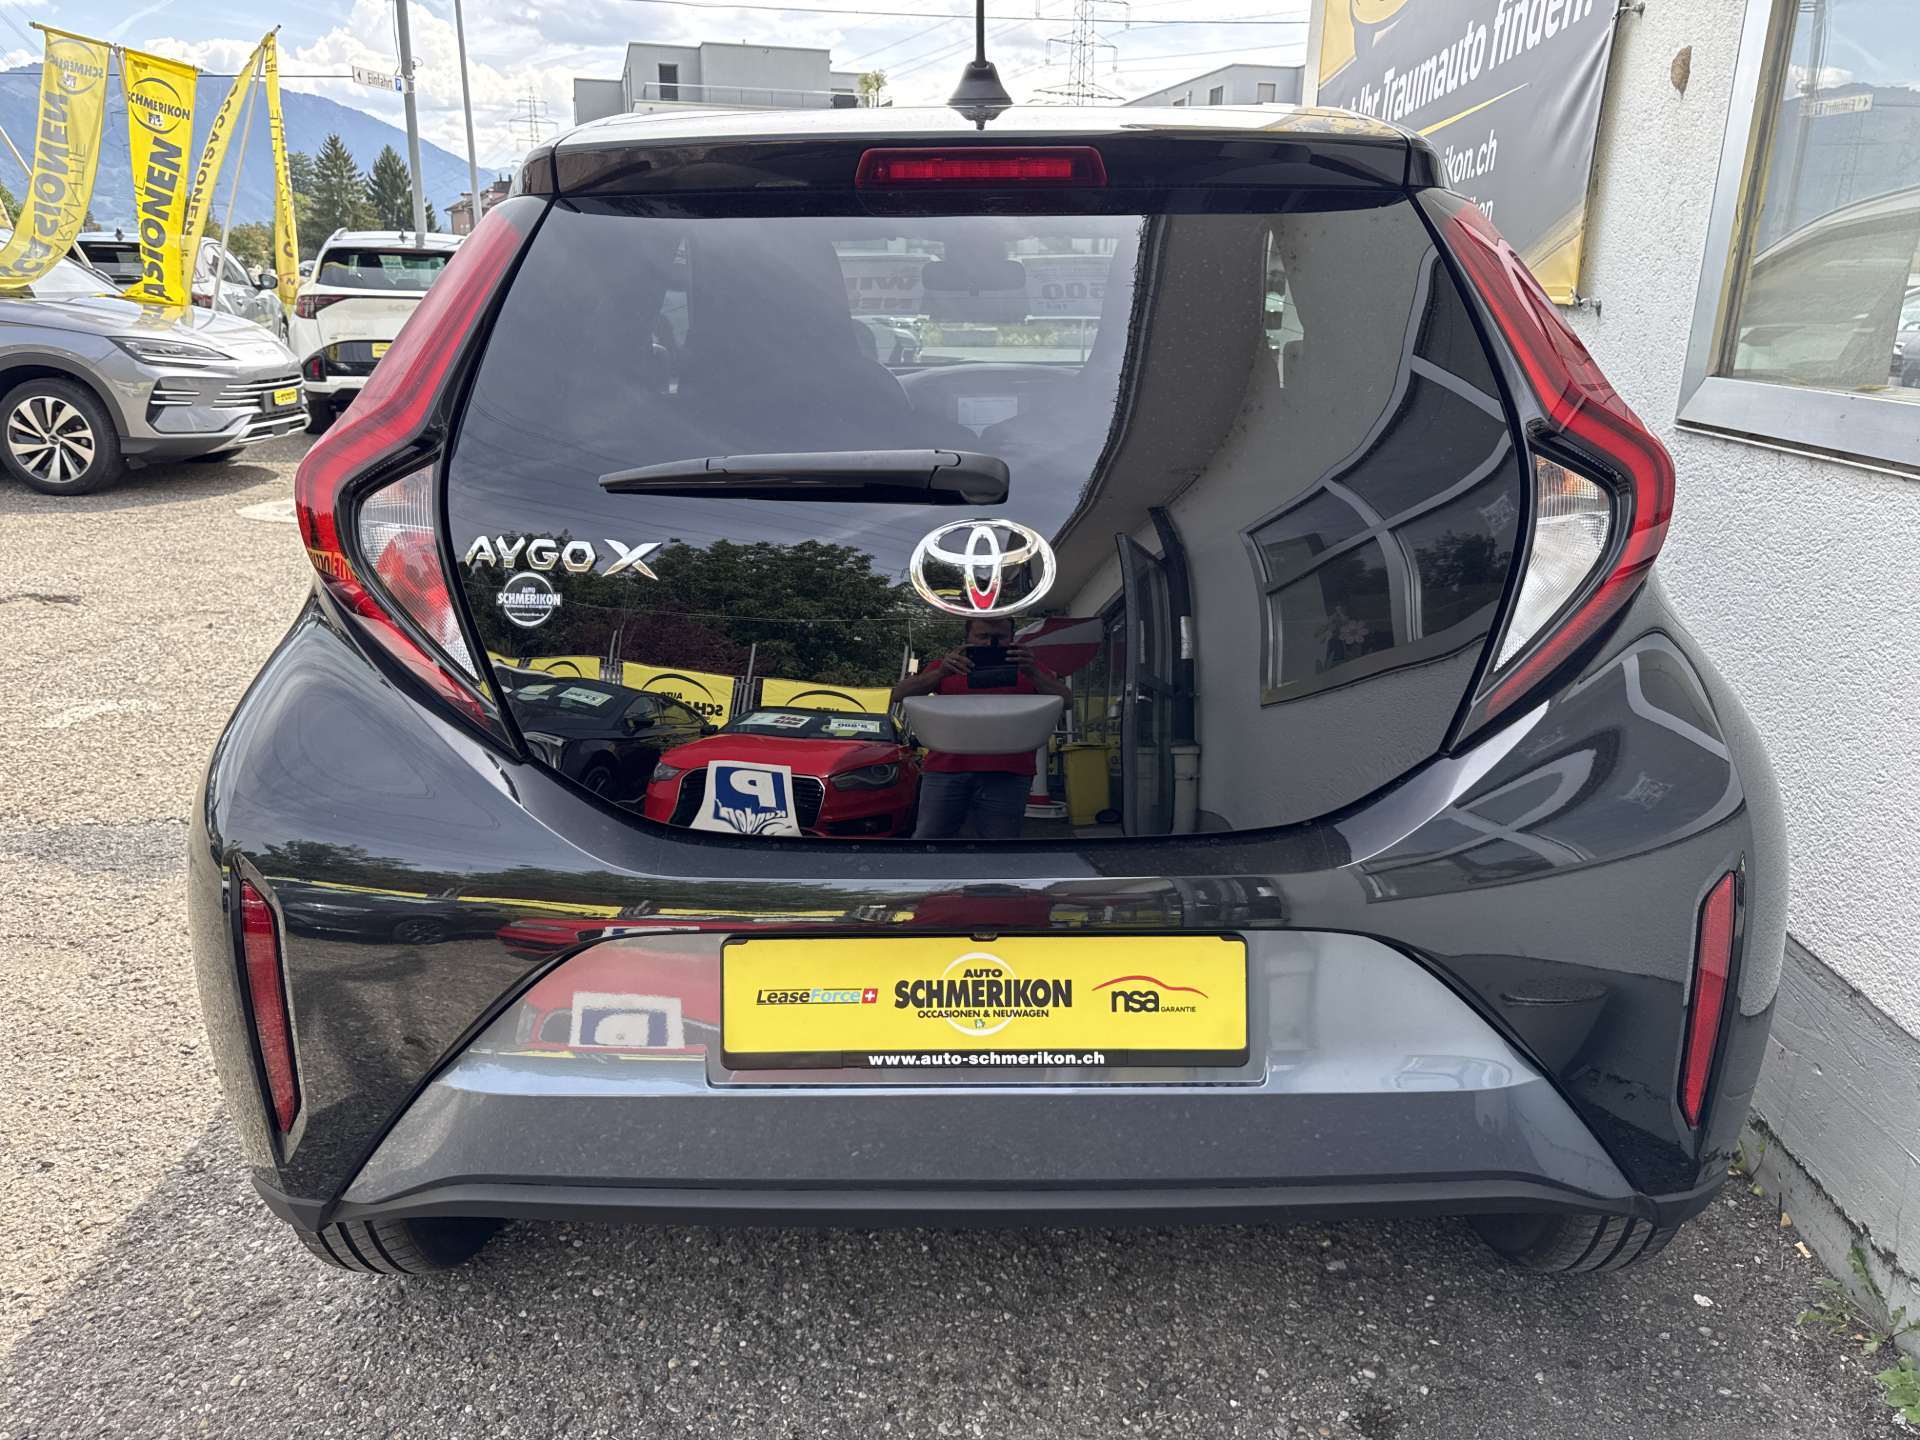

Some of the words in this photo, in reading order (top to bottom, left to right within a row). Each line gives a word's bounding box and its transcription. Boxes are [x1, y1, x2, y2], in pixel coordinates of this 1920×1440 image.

[1359, 83, 1381, 117] Ihr
[1381, 20, 1487, 122] Traumauto
[183, 84, 238, 236] CCASIONEN
[141, 136, 182, 302] ASIONEN
[465, 535, 597, 573] AYGO
[602, 538, 663, 581] X
[497, 592, 561, 606] SCHMERIKON
[963, 968, 1004, 979] AUTO
[756, 987, 861, 1004] LeaseForce
[894, 978, 1073, 1009] SCHMERIKON
[1111, 990, 1160, 1013] nsa
[917, 1009, 981, 1019] OCCASIONEN
[983, 1009, 991, 1018] &
[993, 1009, 1050, 1018] NEUWAGEN
[867, 1051, 1106, 1067] www.auto-schmerikon.ch
